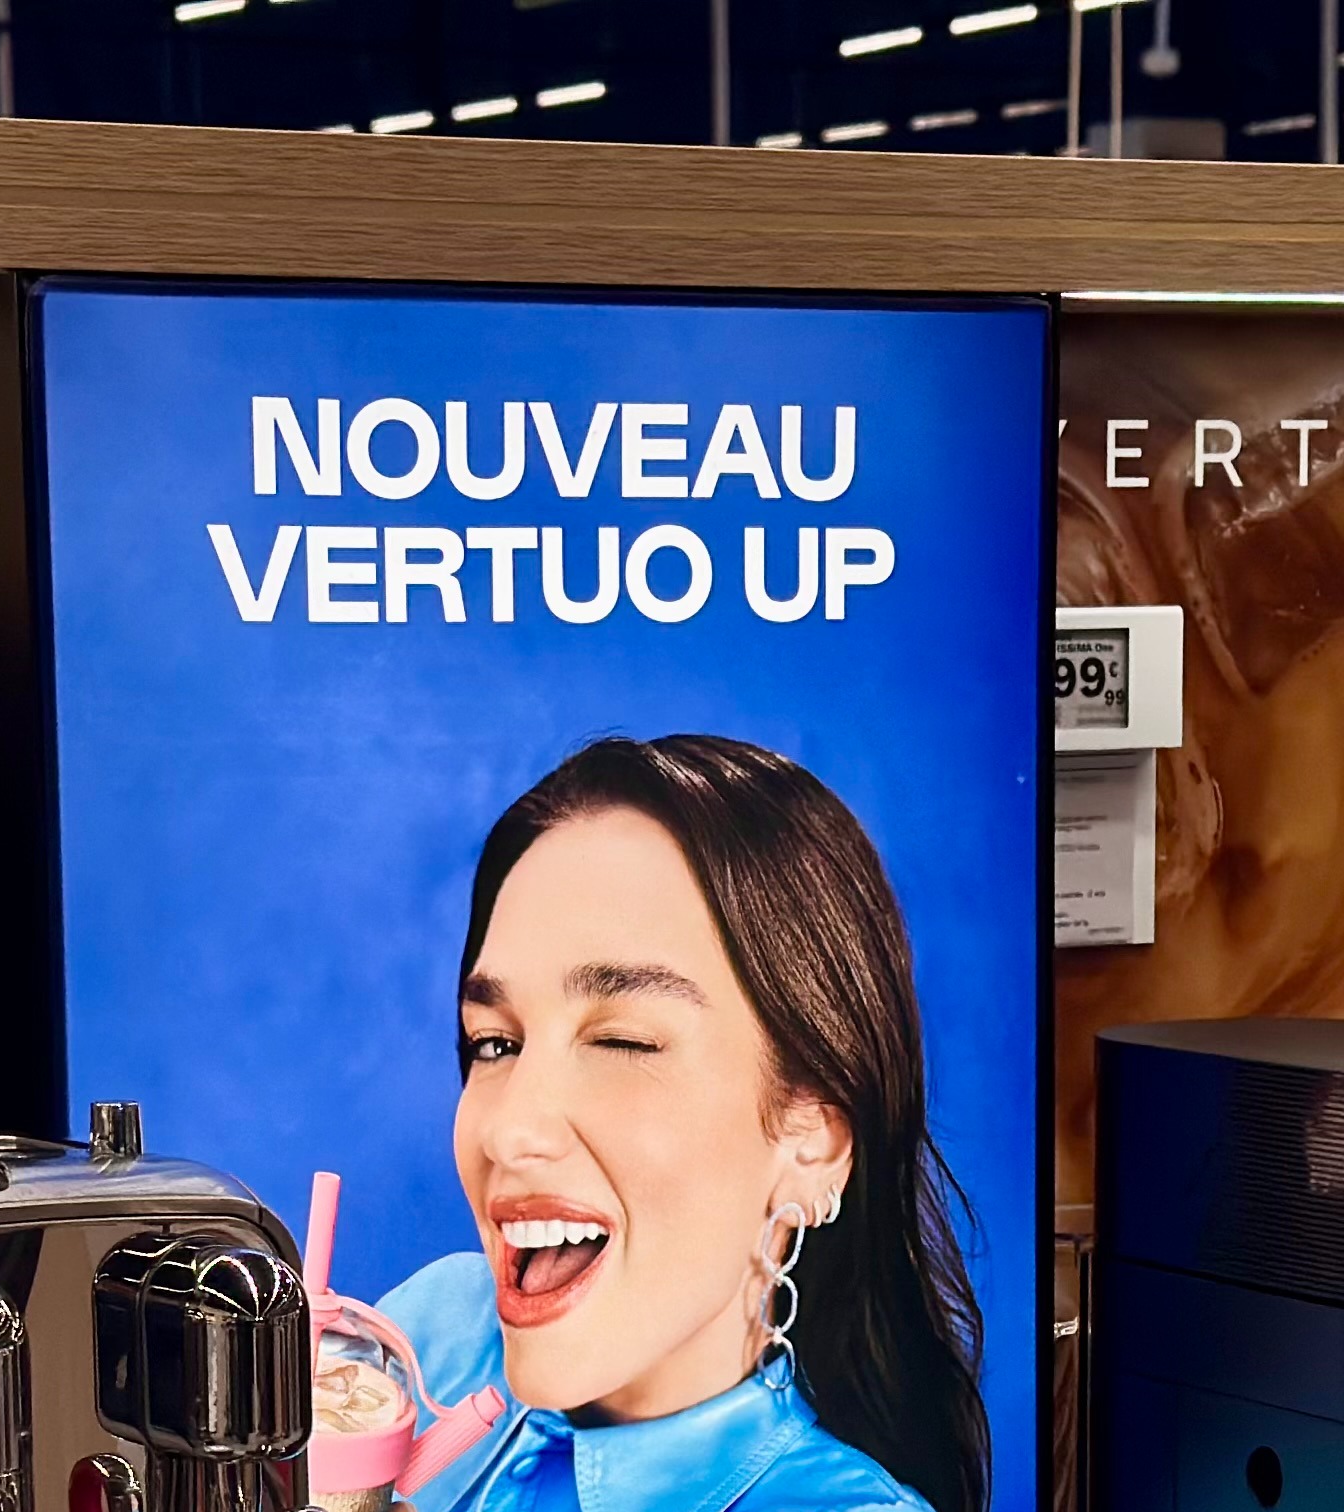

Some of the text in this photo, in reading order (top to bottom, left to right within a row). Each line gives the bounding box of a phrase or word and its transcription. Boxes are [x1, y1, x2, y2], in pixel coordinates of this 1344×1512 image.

[251, 395, 857, 502] NOUVEAU
[206, 523, 896, 625] VERTUO UP
